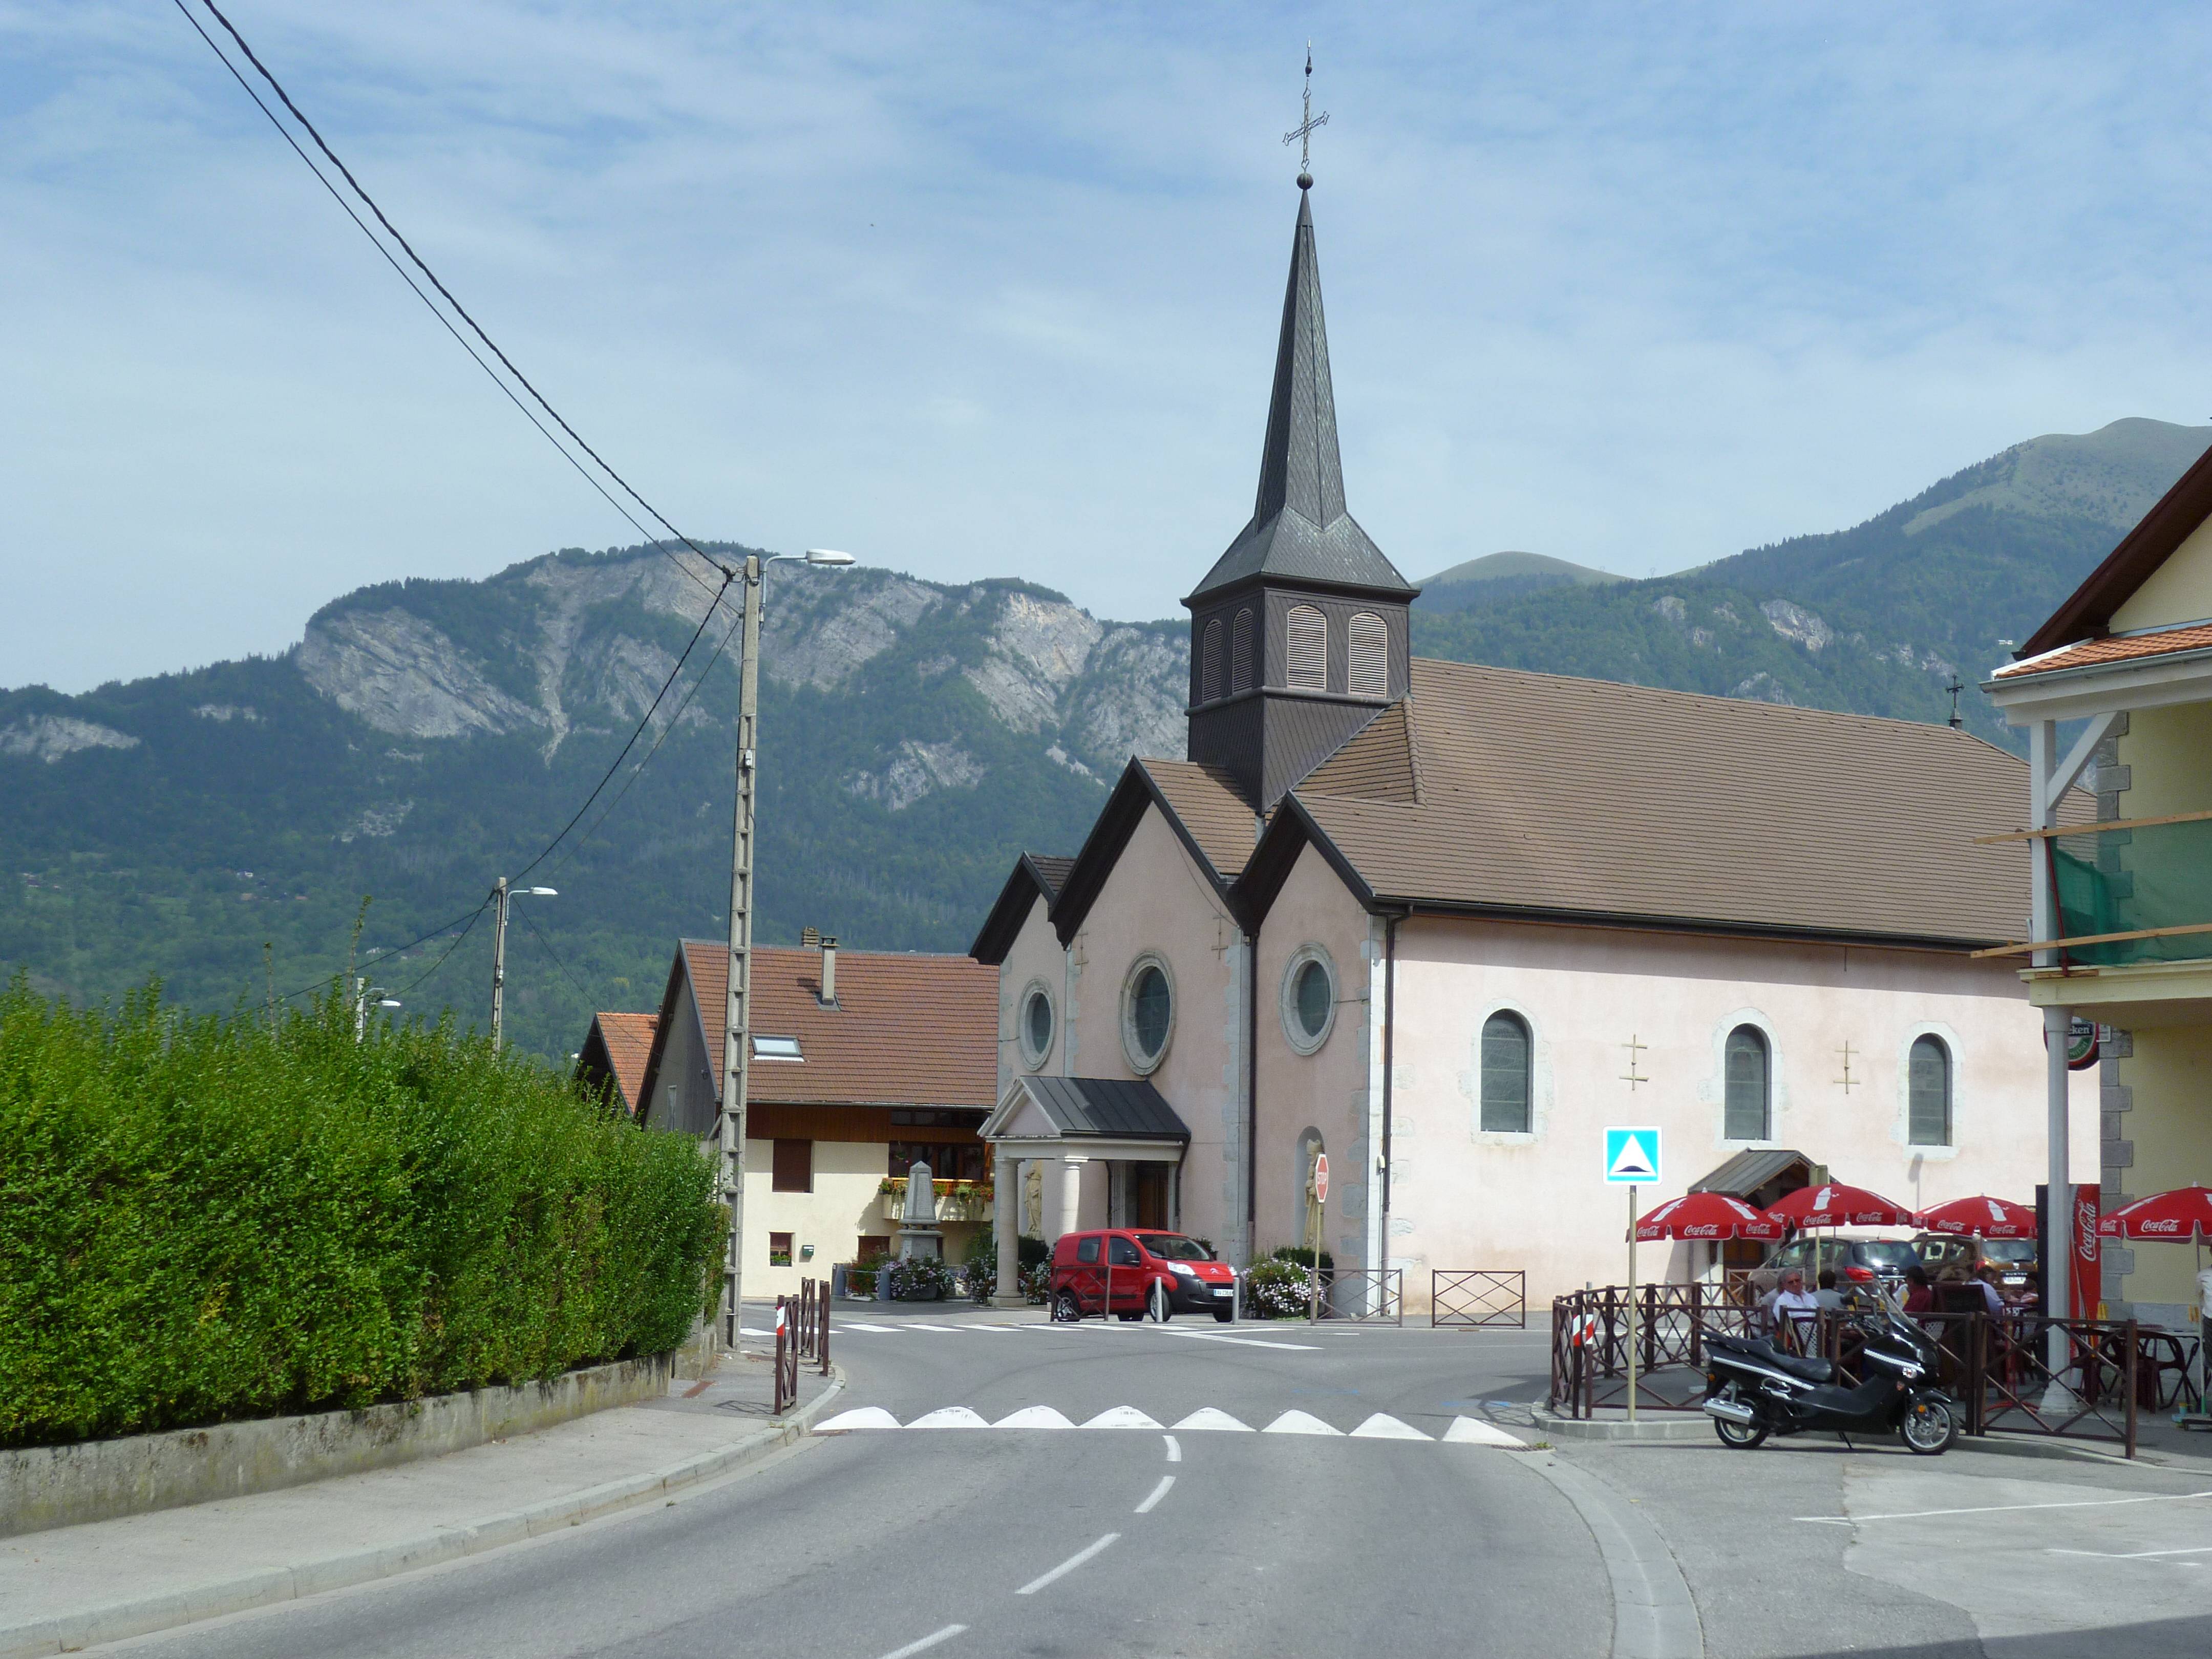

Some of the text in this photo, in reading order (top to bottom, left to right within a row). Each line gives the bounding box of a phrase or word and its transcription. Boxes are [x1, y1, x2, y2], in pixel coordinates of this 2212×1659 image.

[1318, 1172, 1327, 1185] STOP
[1803, 1214, 1833, 1226] Coca-Cola
[1856, 1211, 1884, 1223] Coca-Cola
[1684, 1224, 1719, 1236] Coca-Cola
[1746, 1223, 1771, 1235] Coca-Cola
[1938, 1220, 1965, 1231] Coca-Cola
[1989, 1225, 2017, 1235] Coca-Cola
[2079, 1199, 2097, 1262] Coca-Cola
[2141, 1219, 2181, 1232] Coca-Cola
